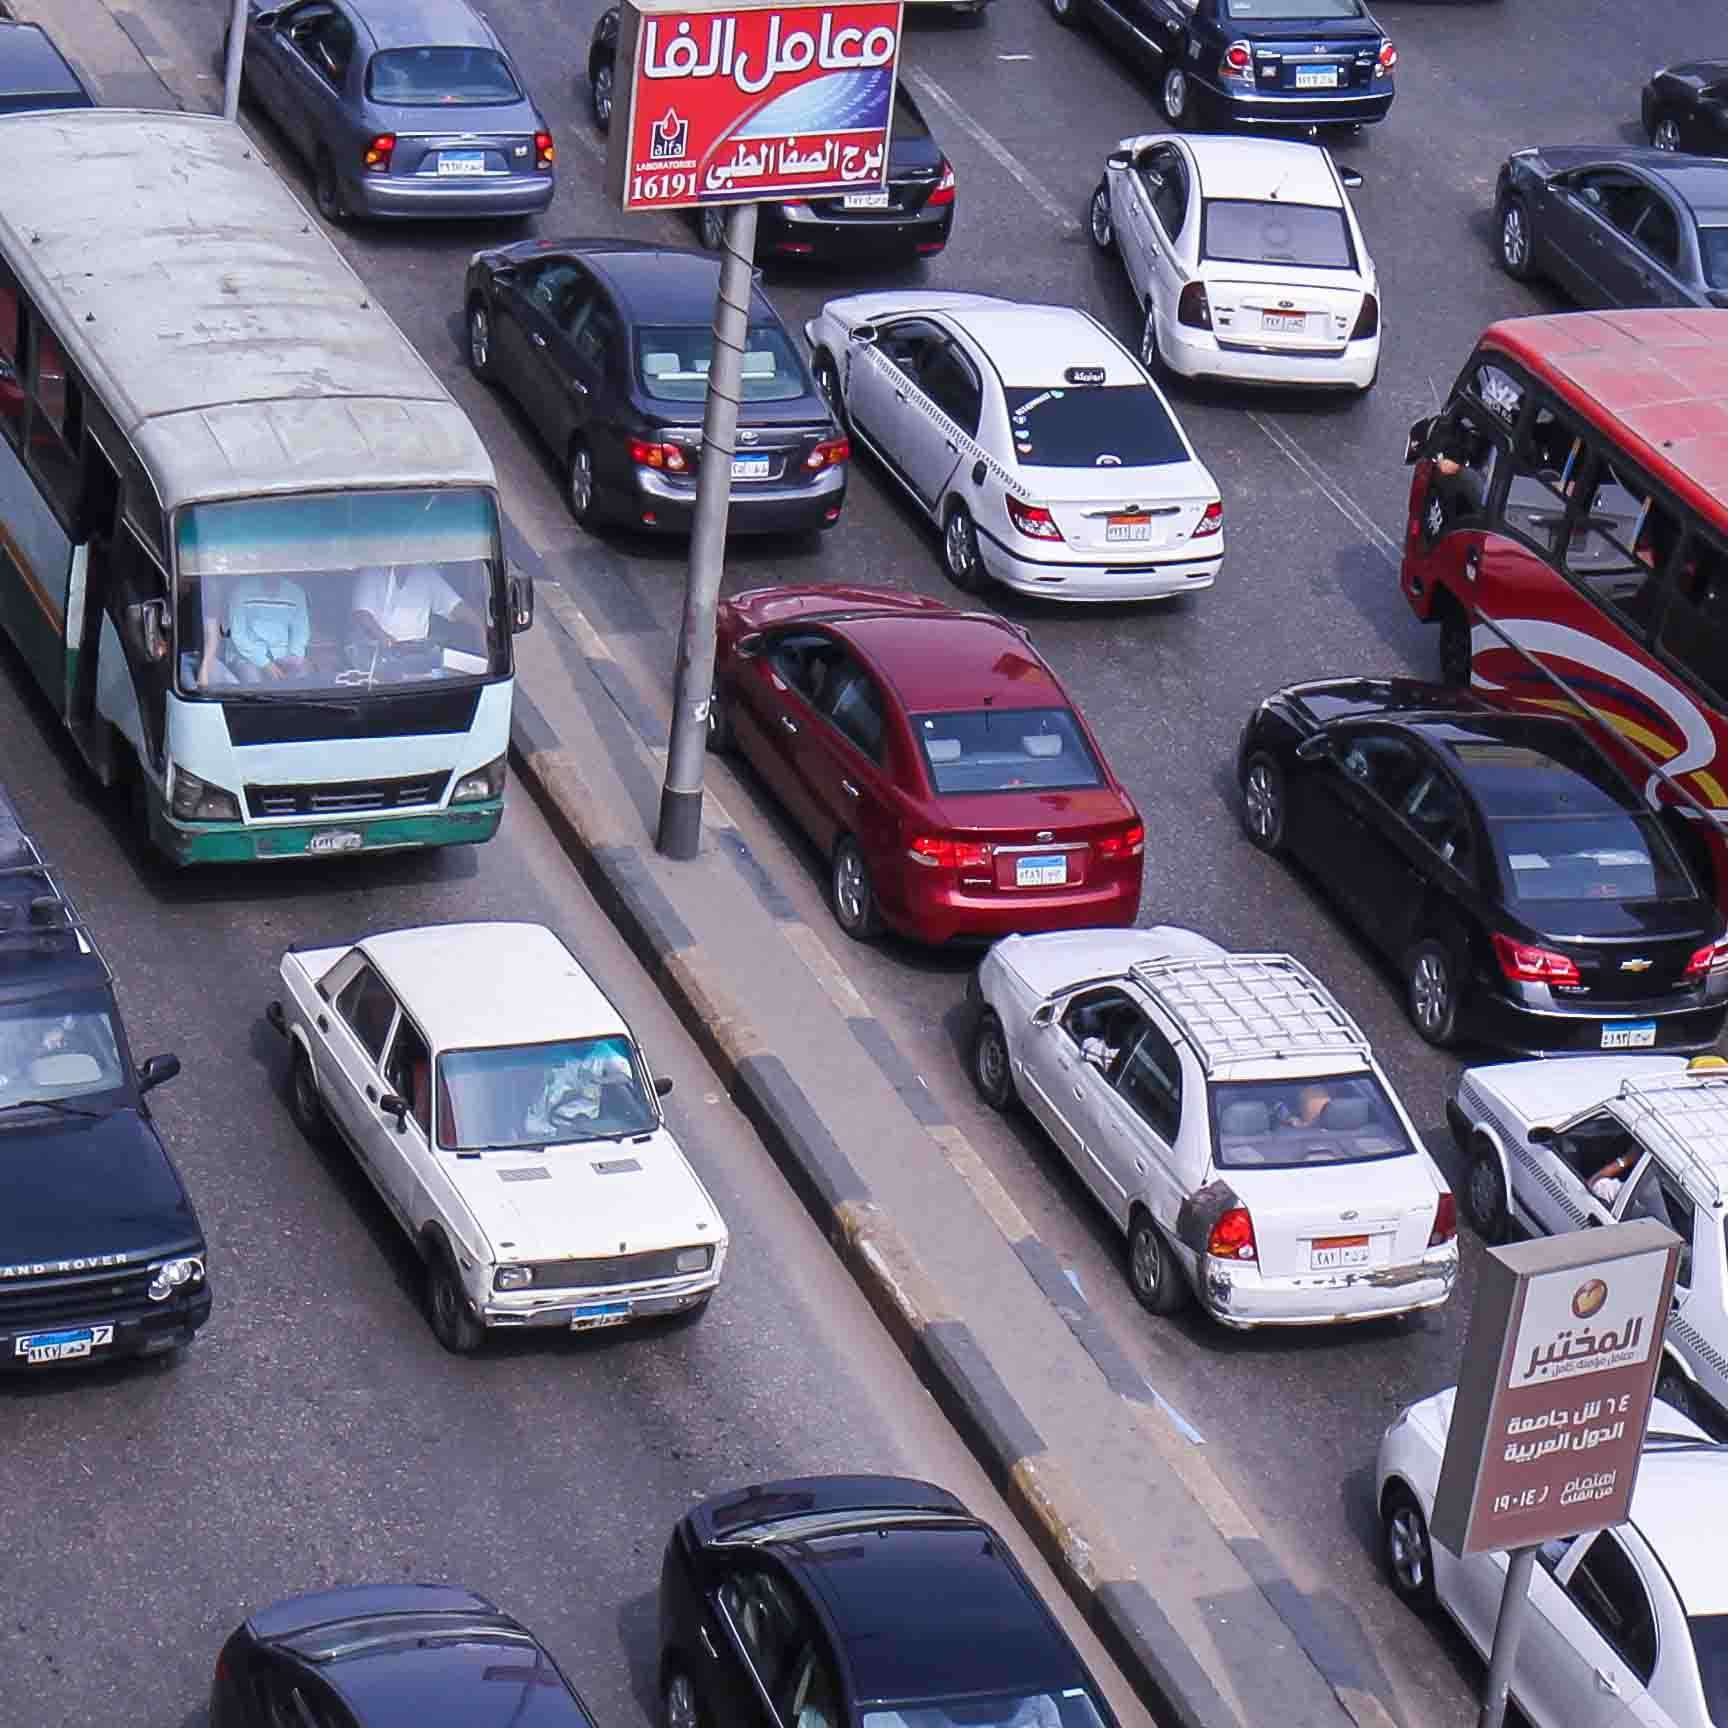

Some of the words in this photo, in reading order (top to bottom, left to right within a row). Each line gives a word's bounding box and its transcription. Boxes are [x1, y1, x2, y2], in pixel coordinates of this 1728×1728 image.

[644, 18, 736, 78] الفا
[734, 13, 896, 93] معامل
[654, 142, 683, 156] alfa
[779, 137, 840, 174] الصفا
[841, 144, 884, 181] برج
[635, 159, 697, 173] LABORATORIES
[631, 174, 698, 200] 16191
[57, 1252, 129, 1273] ROVER
[1523, 1317, 1643, 1379] المختبر
[1507, 1408, 1570, 1435] جامعة
[1504, 1432, 1570, 1463] العربية
[1573, 1422, 1624, 1452] الدول
